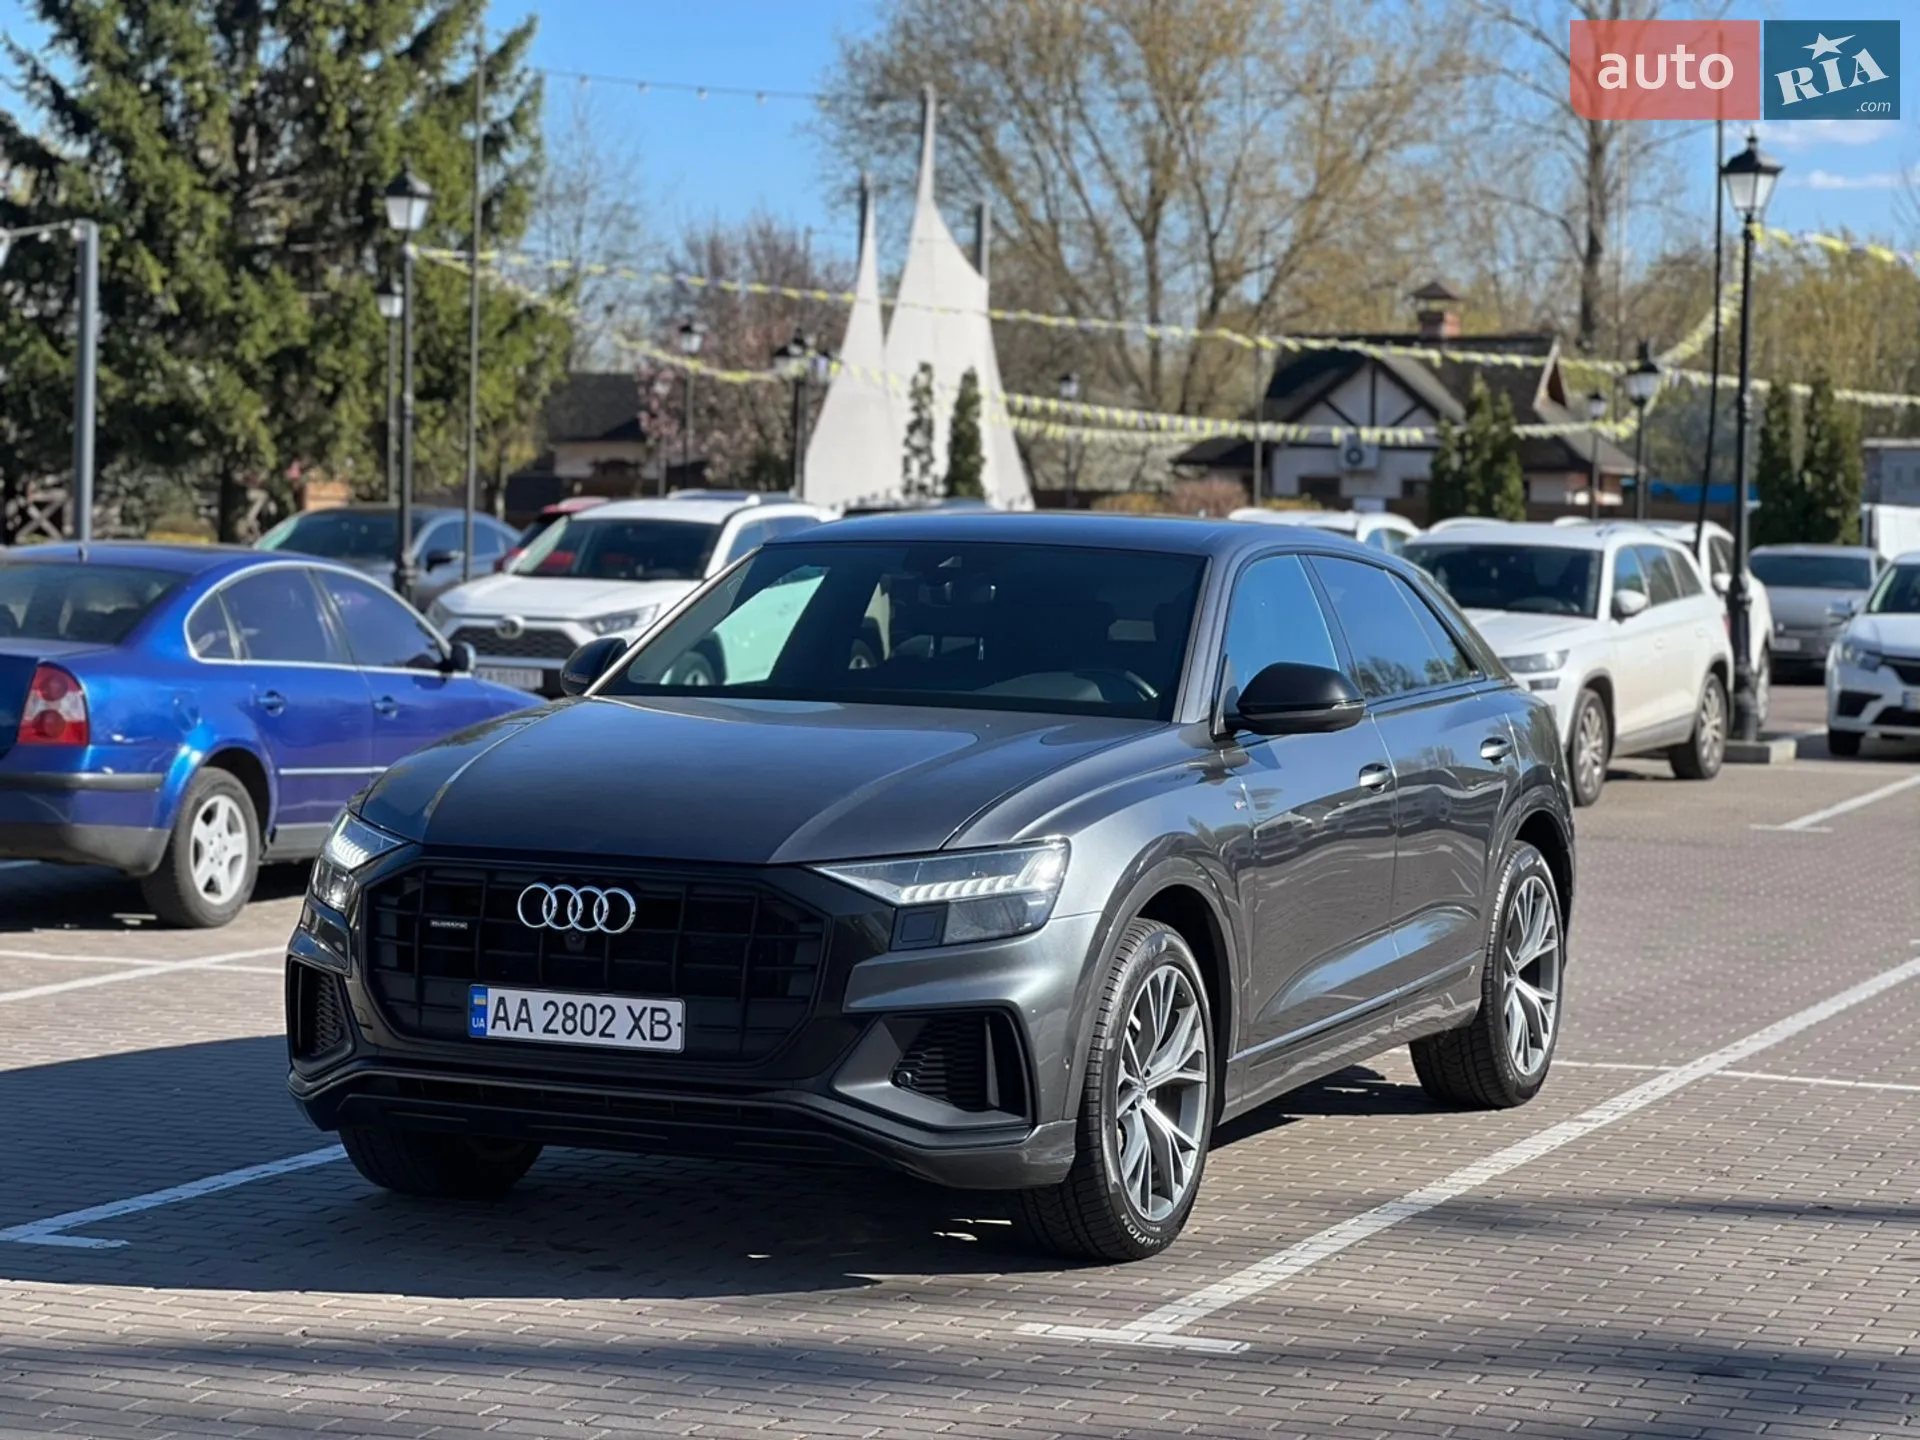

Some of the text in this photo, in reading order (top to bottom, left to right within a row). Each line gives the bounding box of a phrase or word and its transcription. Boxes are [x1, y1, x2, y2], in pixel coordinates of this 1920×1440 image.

[471, 1017, 486, 1028] UA
[491, 996, 673, 1042] AA 2802 XB
